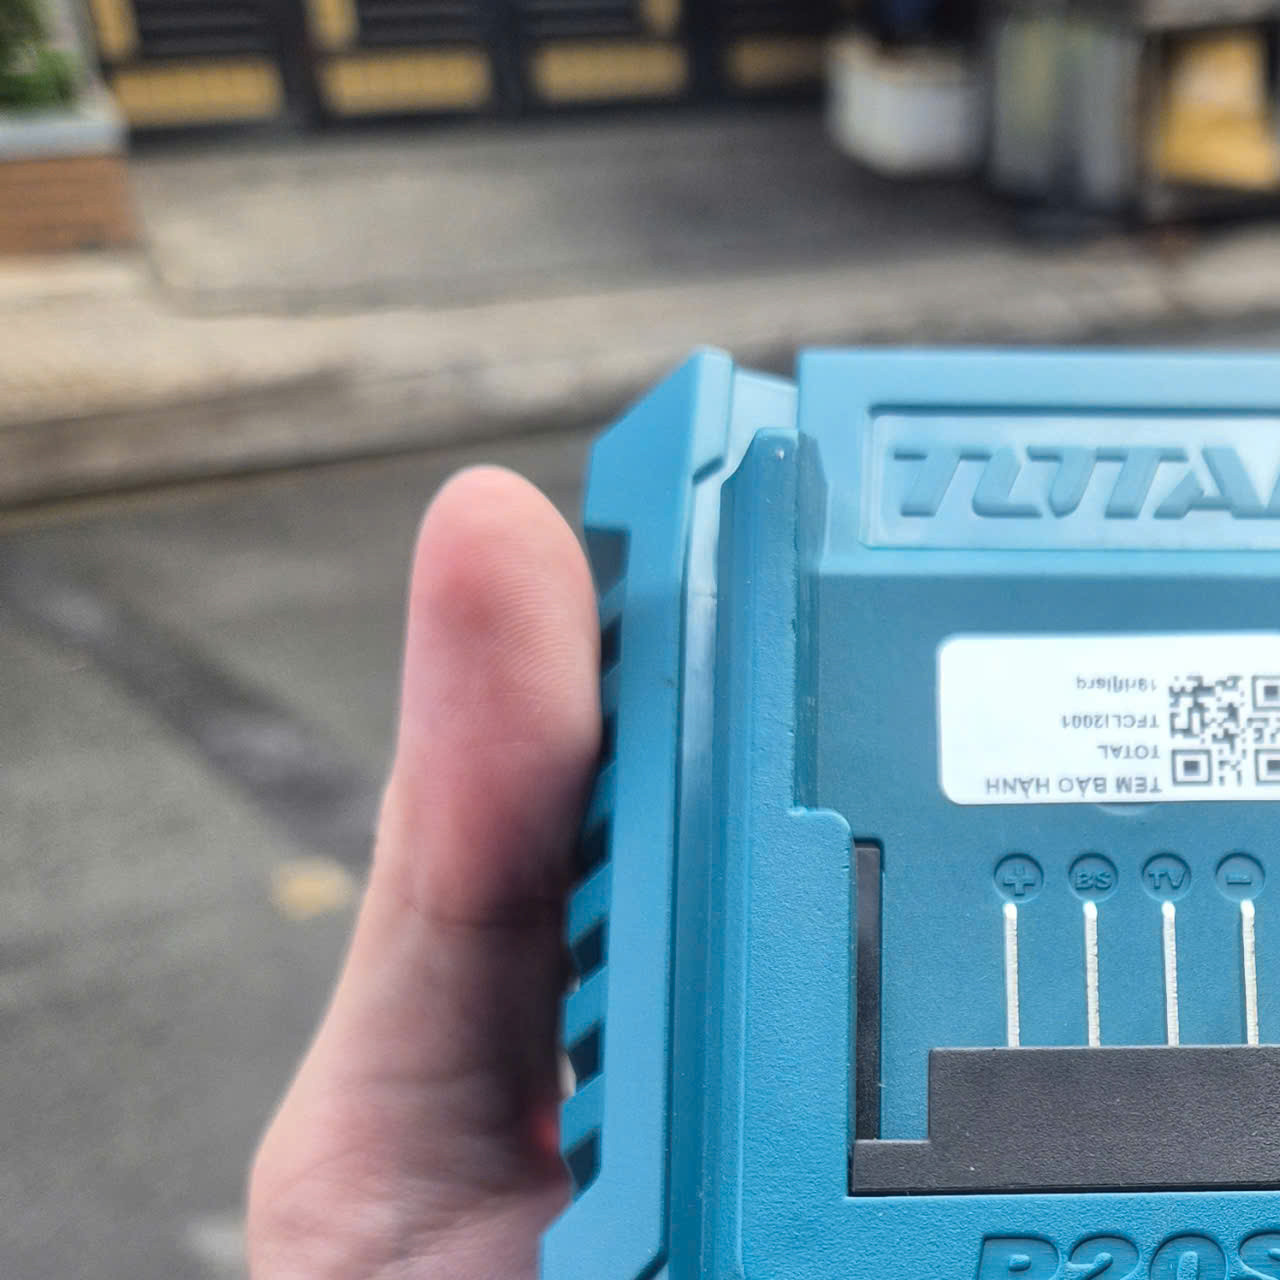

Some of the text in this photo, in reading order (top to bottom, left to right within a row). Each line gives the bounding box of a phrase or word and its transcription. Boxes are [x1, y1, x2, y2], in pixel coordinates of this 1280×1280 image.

[1097, 744, 1161, 760] TOTAL
[1115, 776, 1163, 793] TEM
[1074, 870, 1187, 891] BS TV
